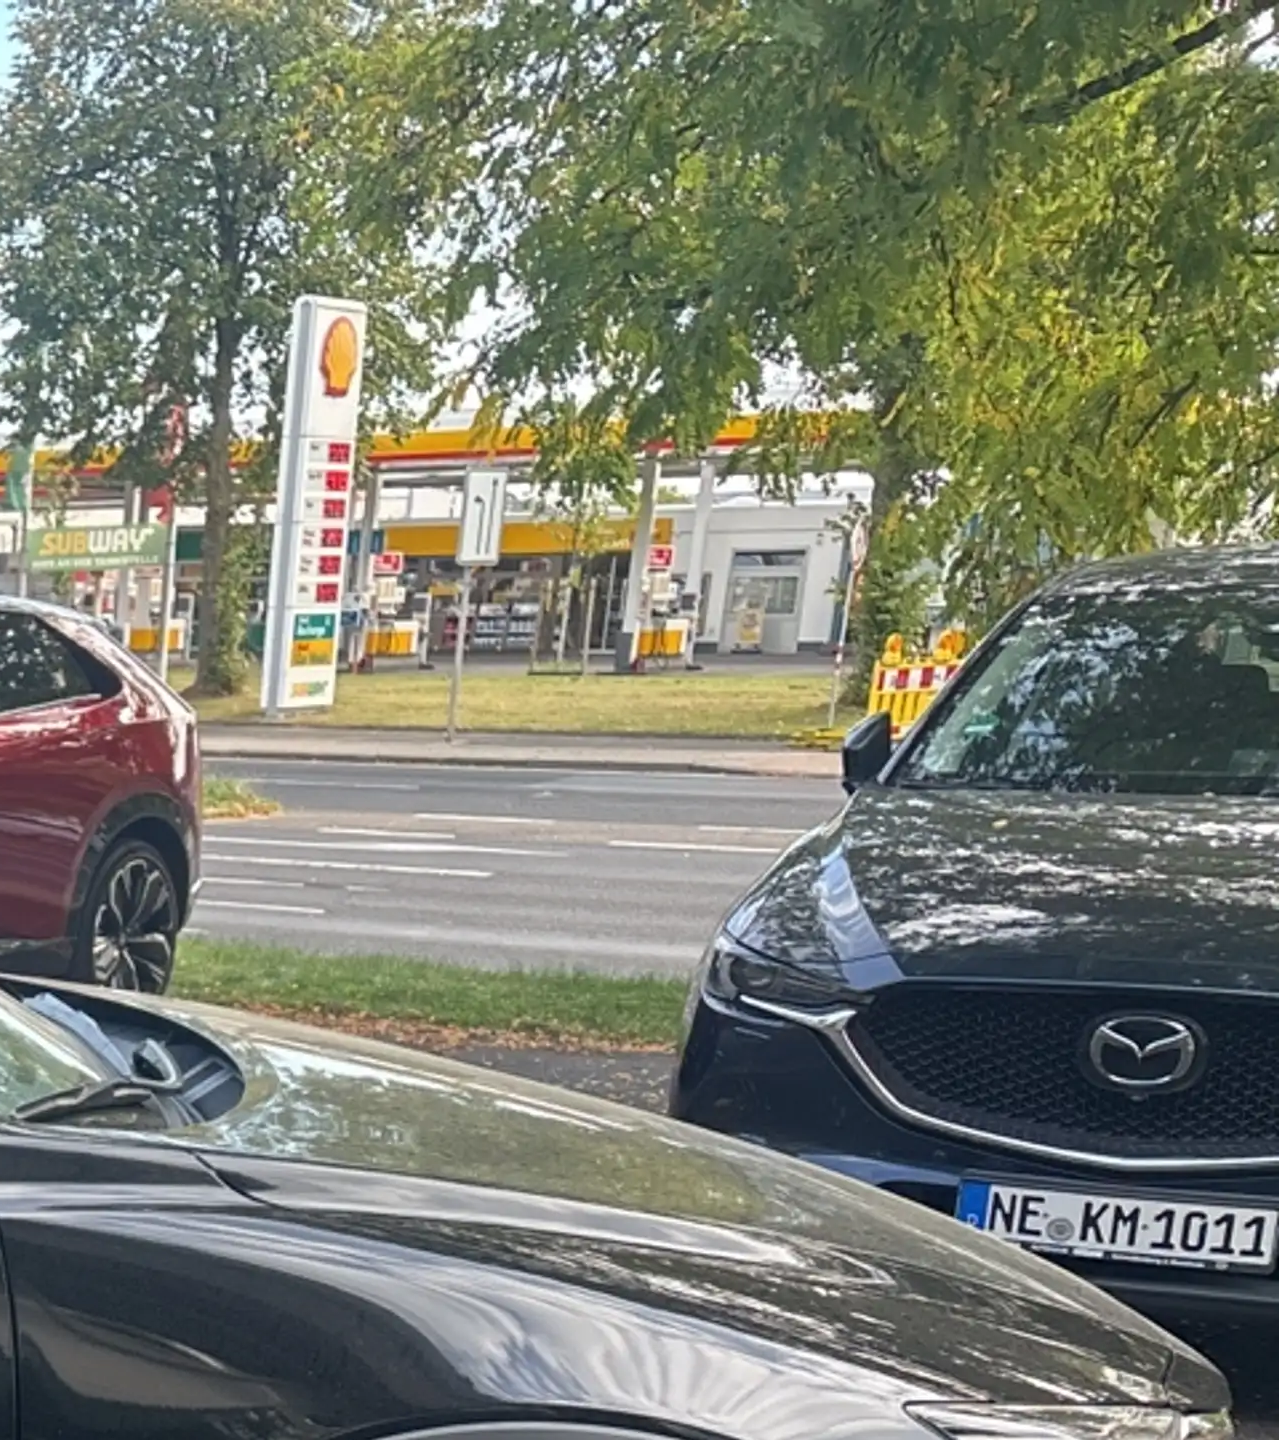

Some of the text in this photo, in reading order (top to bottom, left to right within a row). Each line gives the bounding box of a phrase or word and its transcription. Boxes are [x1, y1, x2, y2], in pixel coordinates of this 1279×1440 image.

[38, 527, 155, 556] SUBWAY
[989, 1191, 1045, 1237] NE
[1079, 1201, 1141, 1247] KM
[1150, 1208, 1267, 1257] 1011
